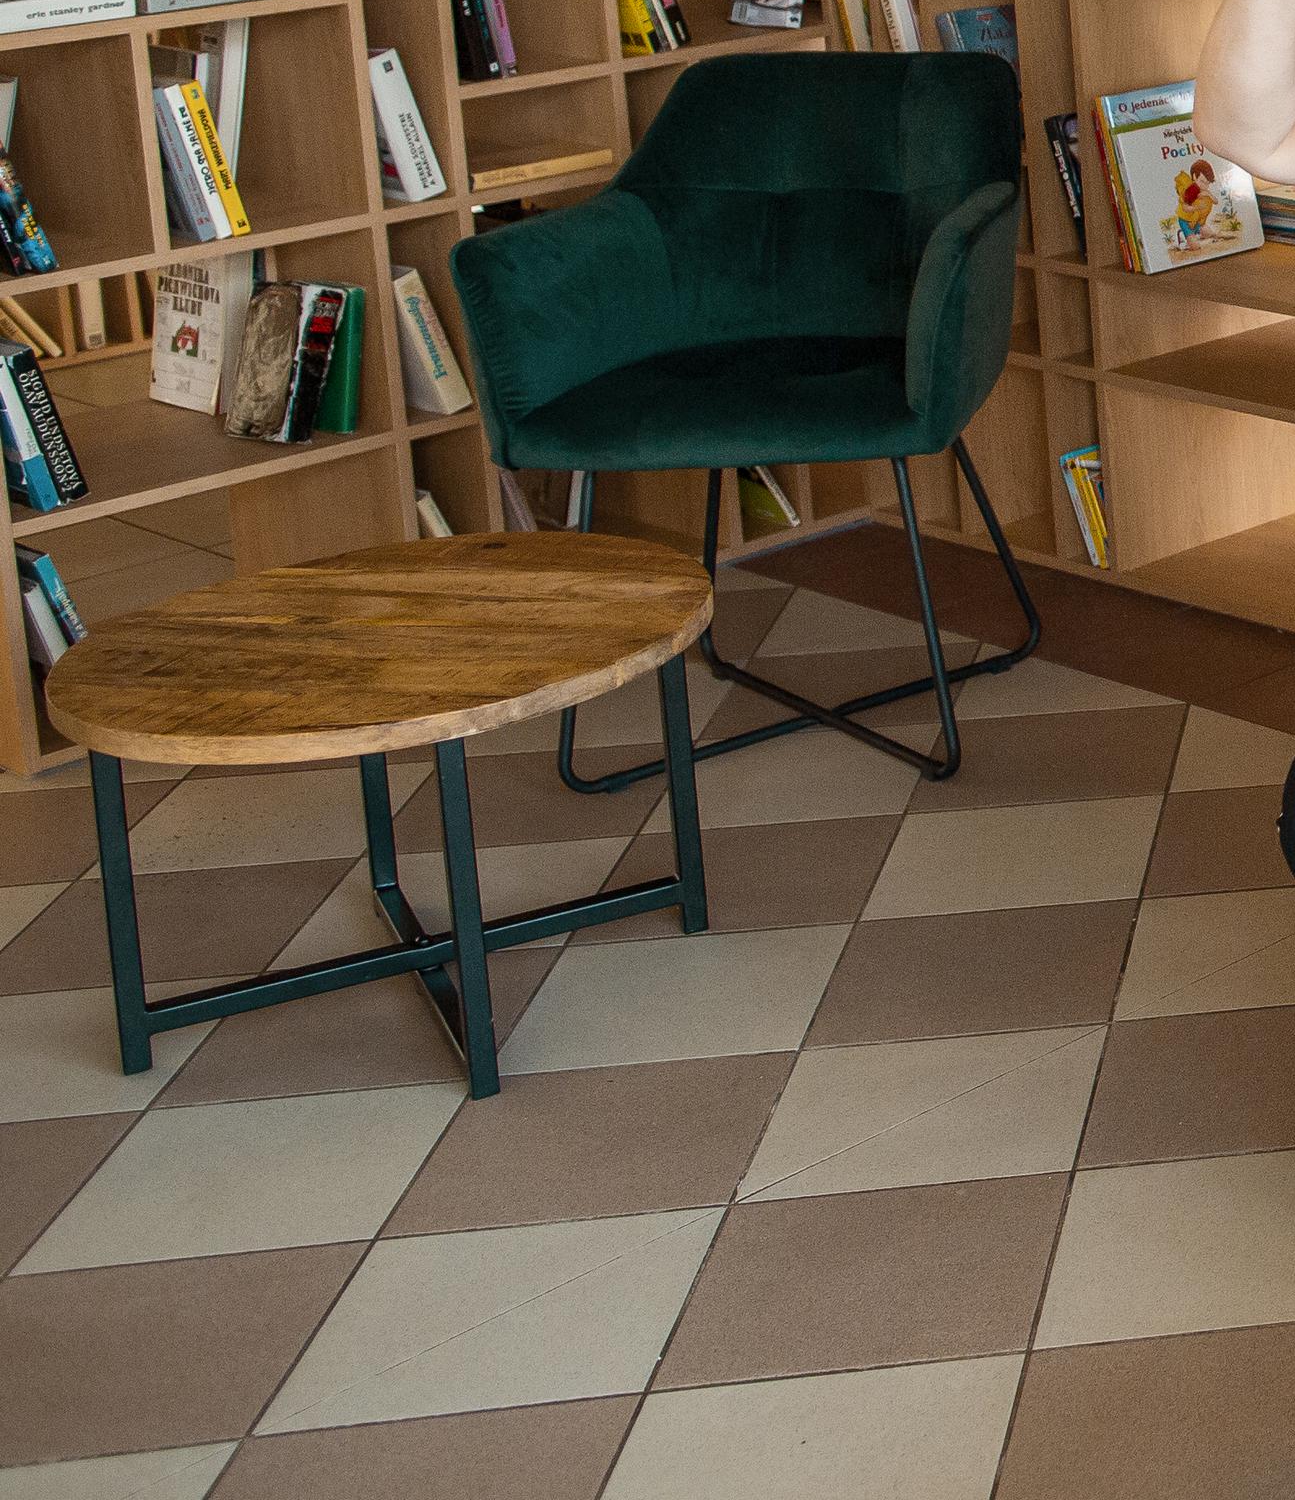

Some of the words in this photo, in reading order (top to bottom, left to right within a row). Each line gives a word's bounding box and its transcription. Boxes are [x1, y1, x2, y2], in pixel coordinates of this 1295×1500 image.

[49, 4, 85, 19] stanley
[87, 0, 126, 15] gardner
[1160, 143, 1205, 161] Pocity
[18, 373, 38, 406] OLAV
[29, 369, 52, 413] SIGRID
[48, 415, 84, 491] UNDSETOVÁ
